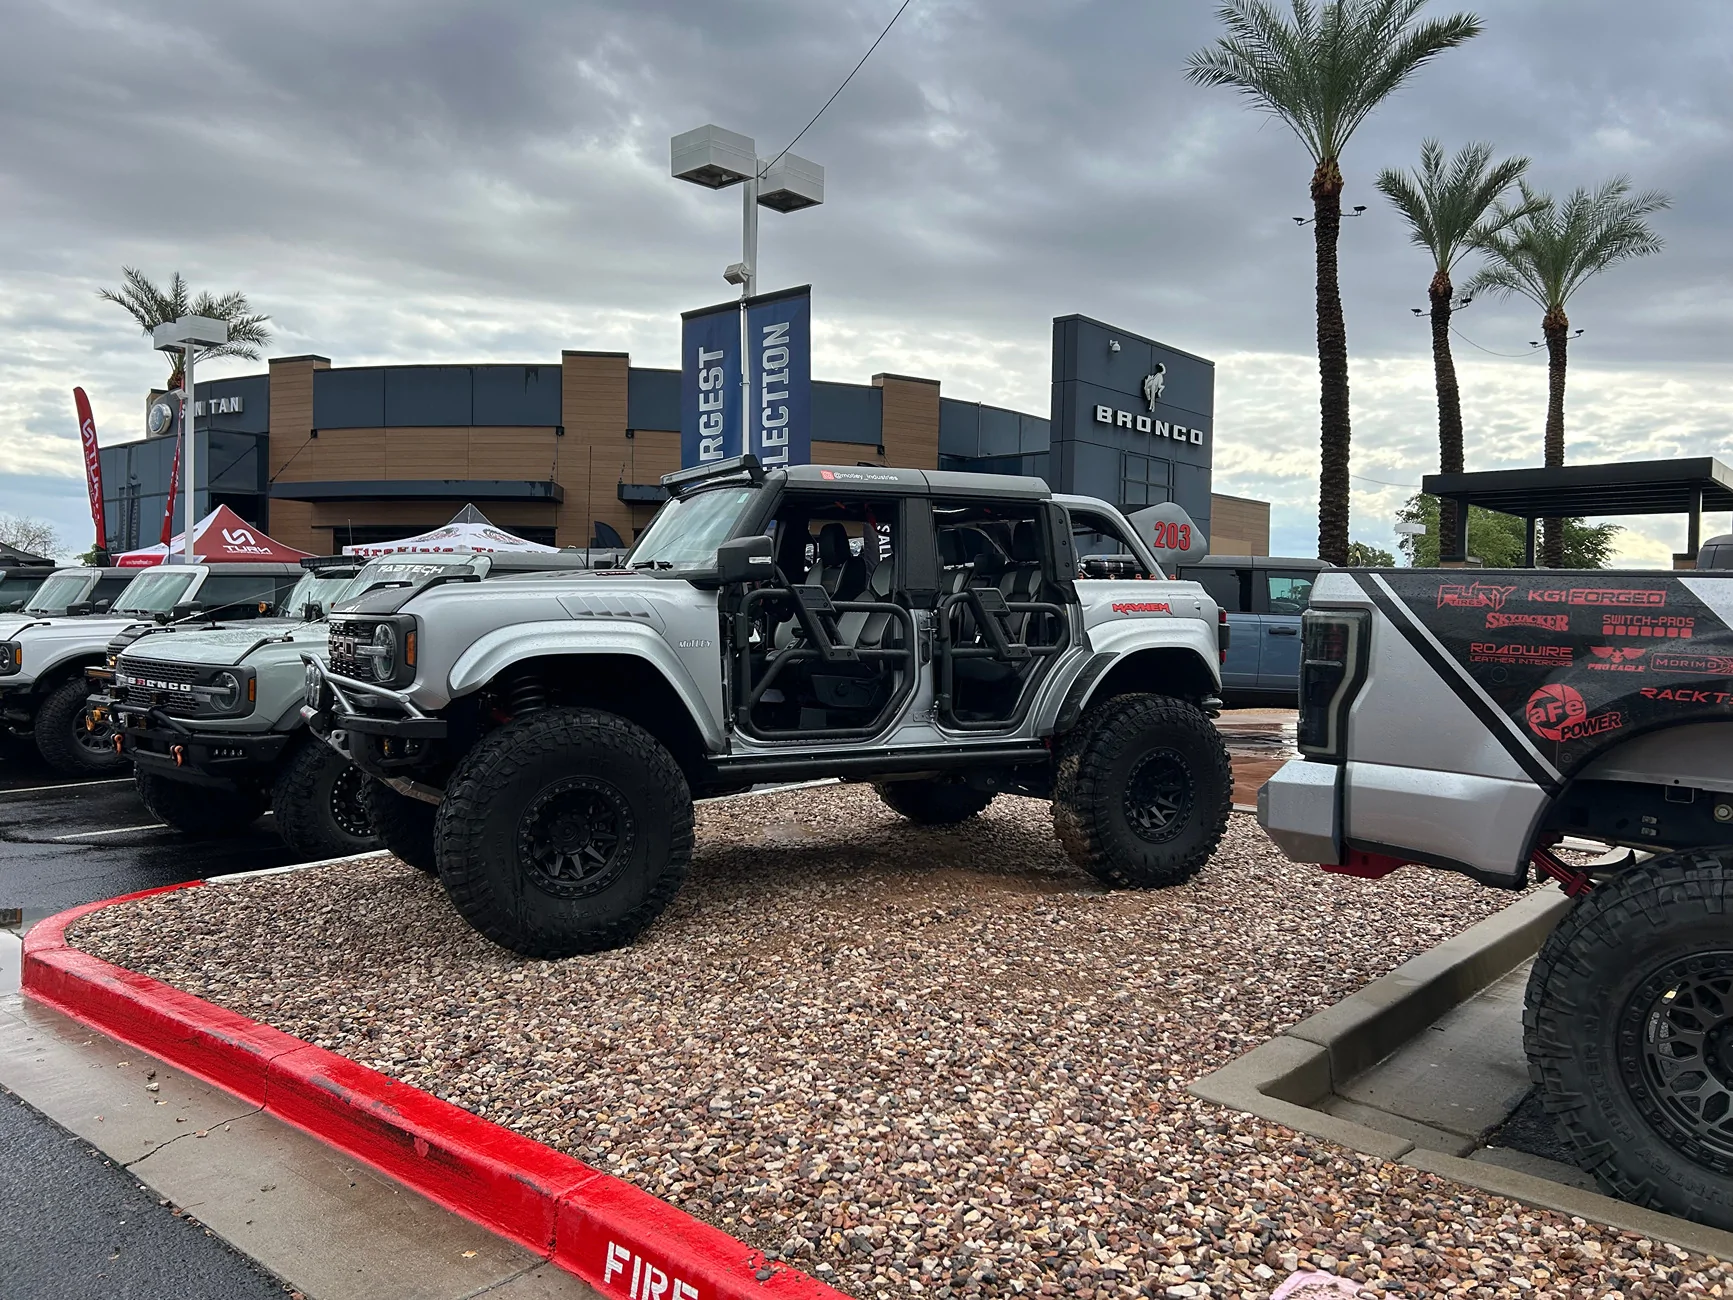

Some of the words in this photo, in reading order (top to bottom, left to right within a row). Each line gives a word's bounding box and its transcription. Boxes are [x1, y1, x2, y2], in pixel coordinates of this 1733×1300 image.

[699, 347, 724, 461] RGEST
[762, 322, 789, 471] LECTION
[180, 402, 204, 419] SN
[209, 397, 242, 415] TAN
[1096, 404, 1203, 446] BRONCO
[1153, 521, 1191, 551] 203
[377, 564, 445, 577] FABTECH
[1437, 581, 1517, 611] FURY
[1528, 590, 1566, 602] KG1
[1569, 590, 1666, 606] FORGED
[1112, 602, 1173, 616] MAYHEM
[1485, 612, 1569, 631] SKYJACKER
[1602, 614, 1695, 627] SWITCH-PROS
[1470, 642, 1574, 658] ROADWIRE
[1469, 655, 1516, 664] LEATHER
[1518, 659, 1573, 667] INTERIORS
[1588, 663, 1609, 671] PRO
[1610, 664, 1645, 673] EAGLE
[127, 677, 191, 692] BRONCO
[1640, 687, 1733, 705] RACKT
[1530, 701, 1583, 723] aFe
[1561, 712, 1622, 742] POWER
